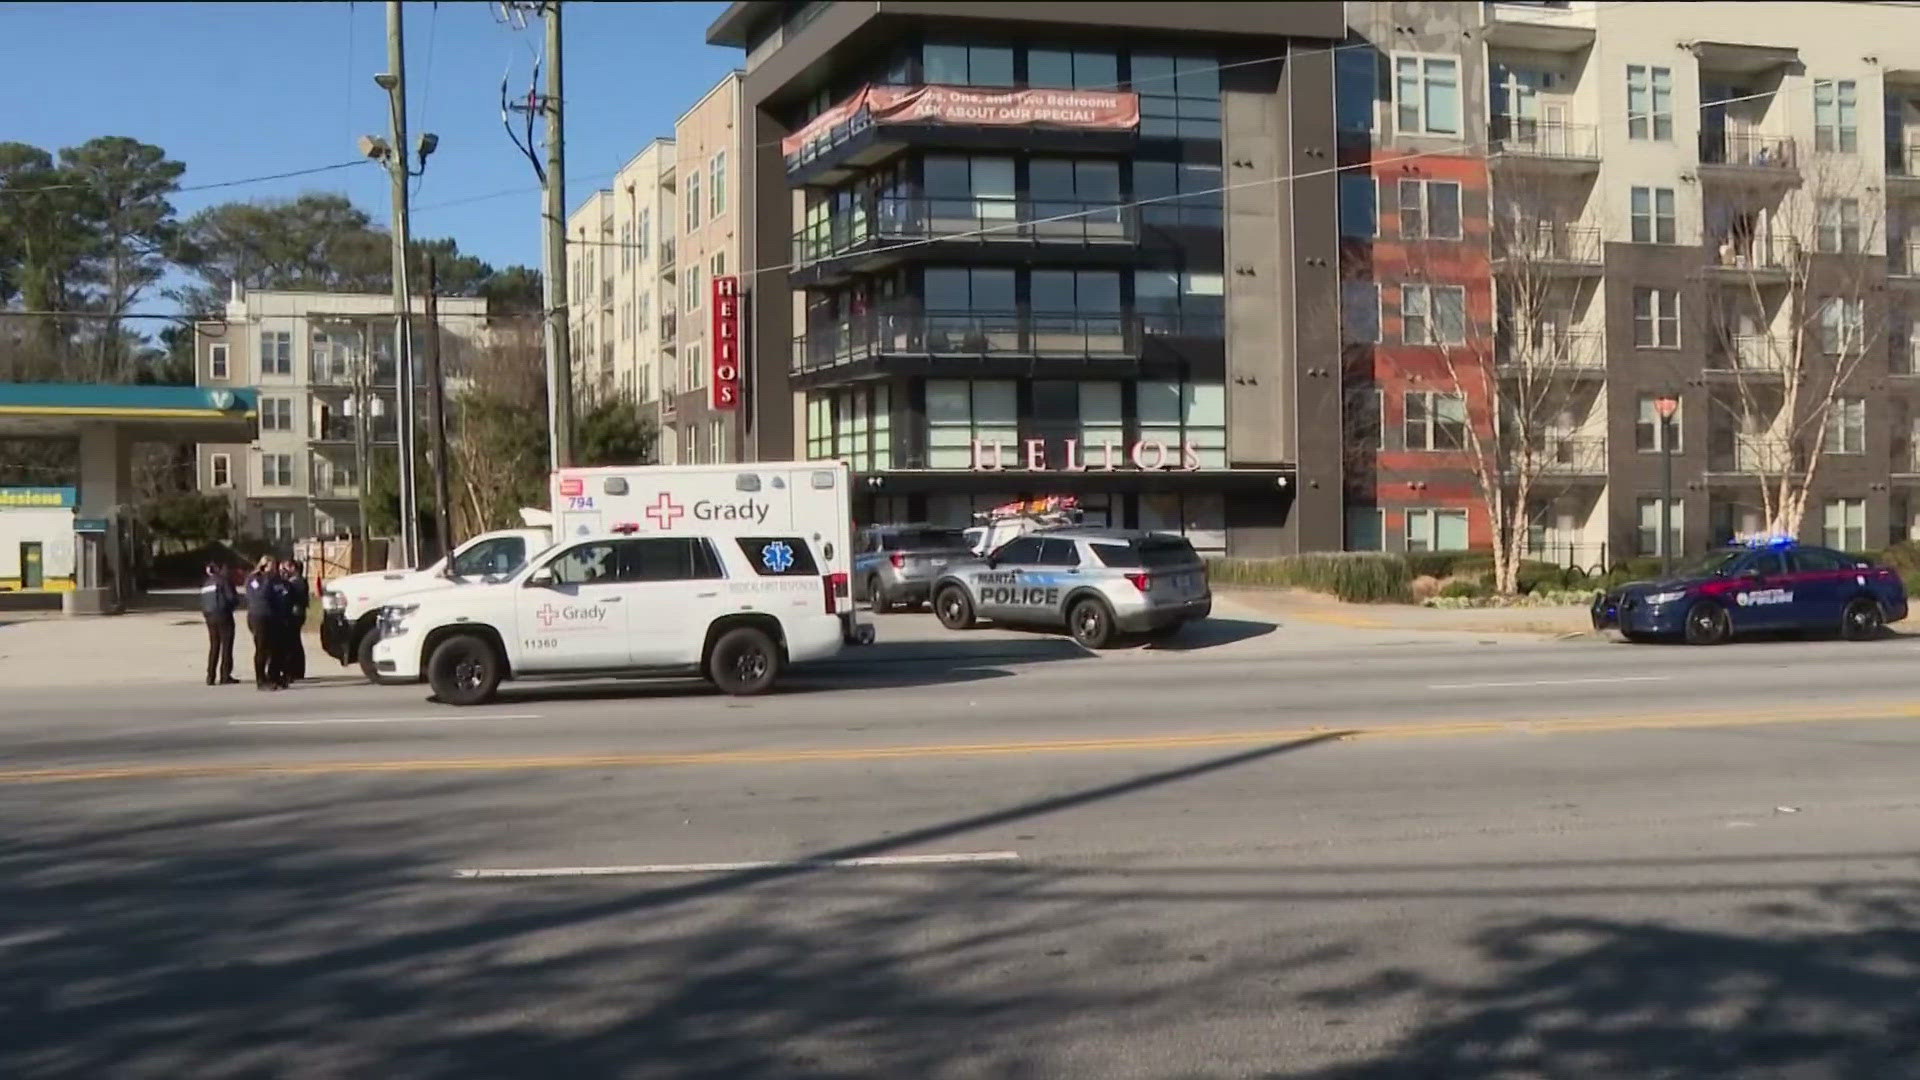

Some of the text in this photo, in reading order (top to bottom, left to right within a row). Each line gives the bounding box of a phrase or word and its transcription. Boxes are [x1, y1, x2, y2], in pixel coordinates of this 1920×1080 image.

[1047, 94, 1117, 109] Bedrooms
[914, 104, 1096, 122] ASK ABOUT OUR SPECIAL!
[717, 280, 735, 402] HELIOS
[972, 438, 1201, 471] HELIOS
[569, 496, 594, 509] 794
[693, 498, 769, 523] Grady
[980, 586, 1059, 605] POLICE
[562, 605, 607, 621] Grady
[524, 638, 558, 648] 11360
